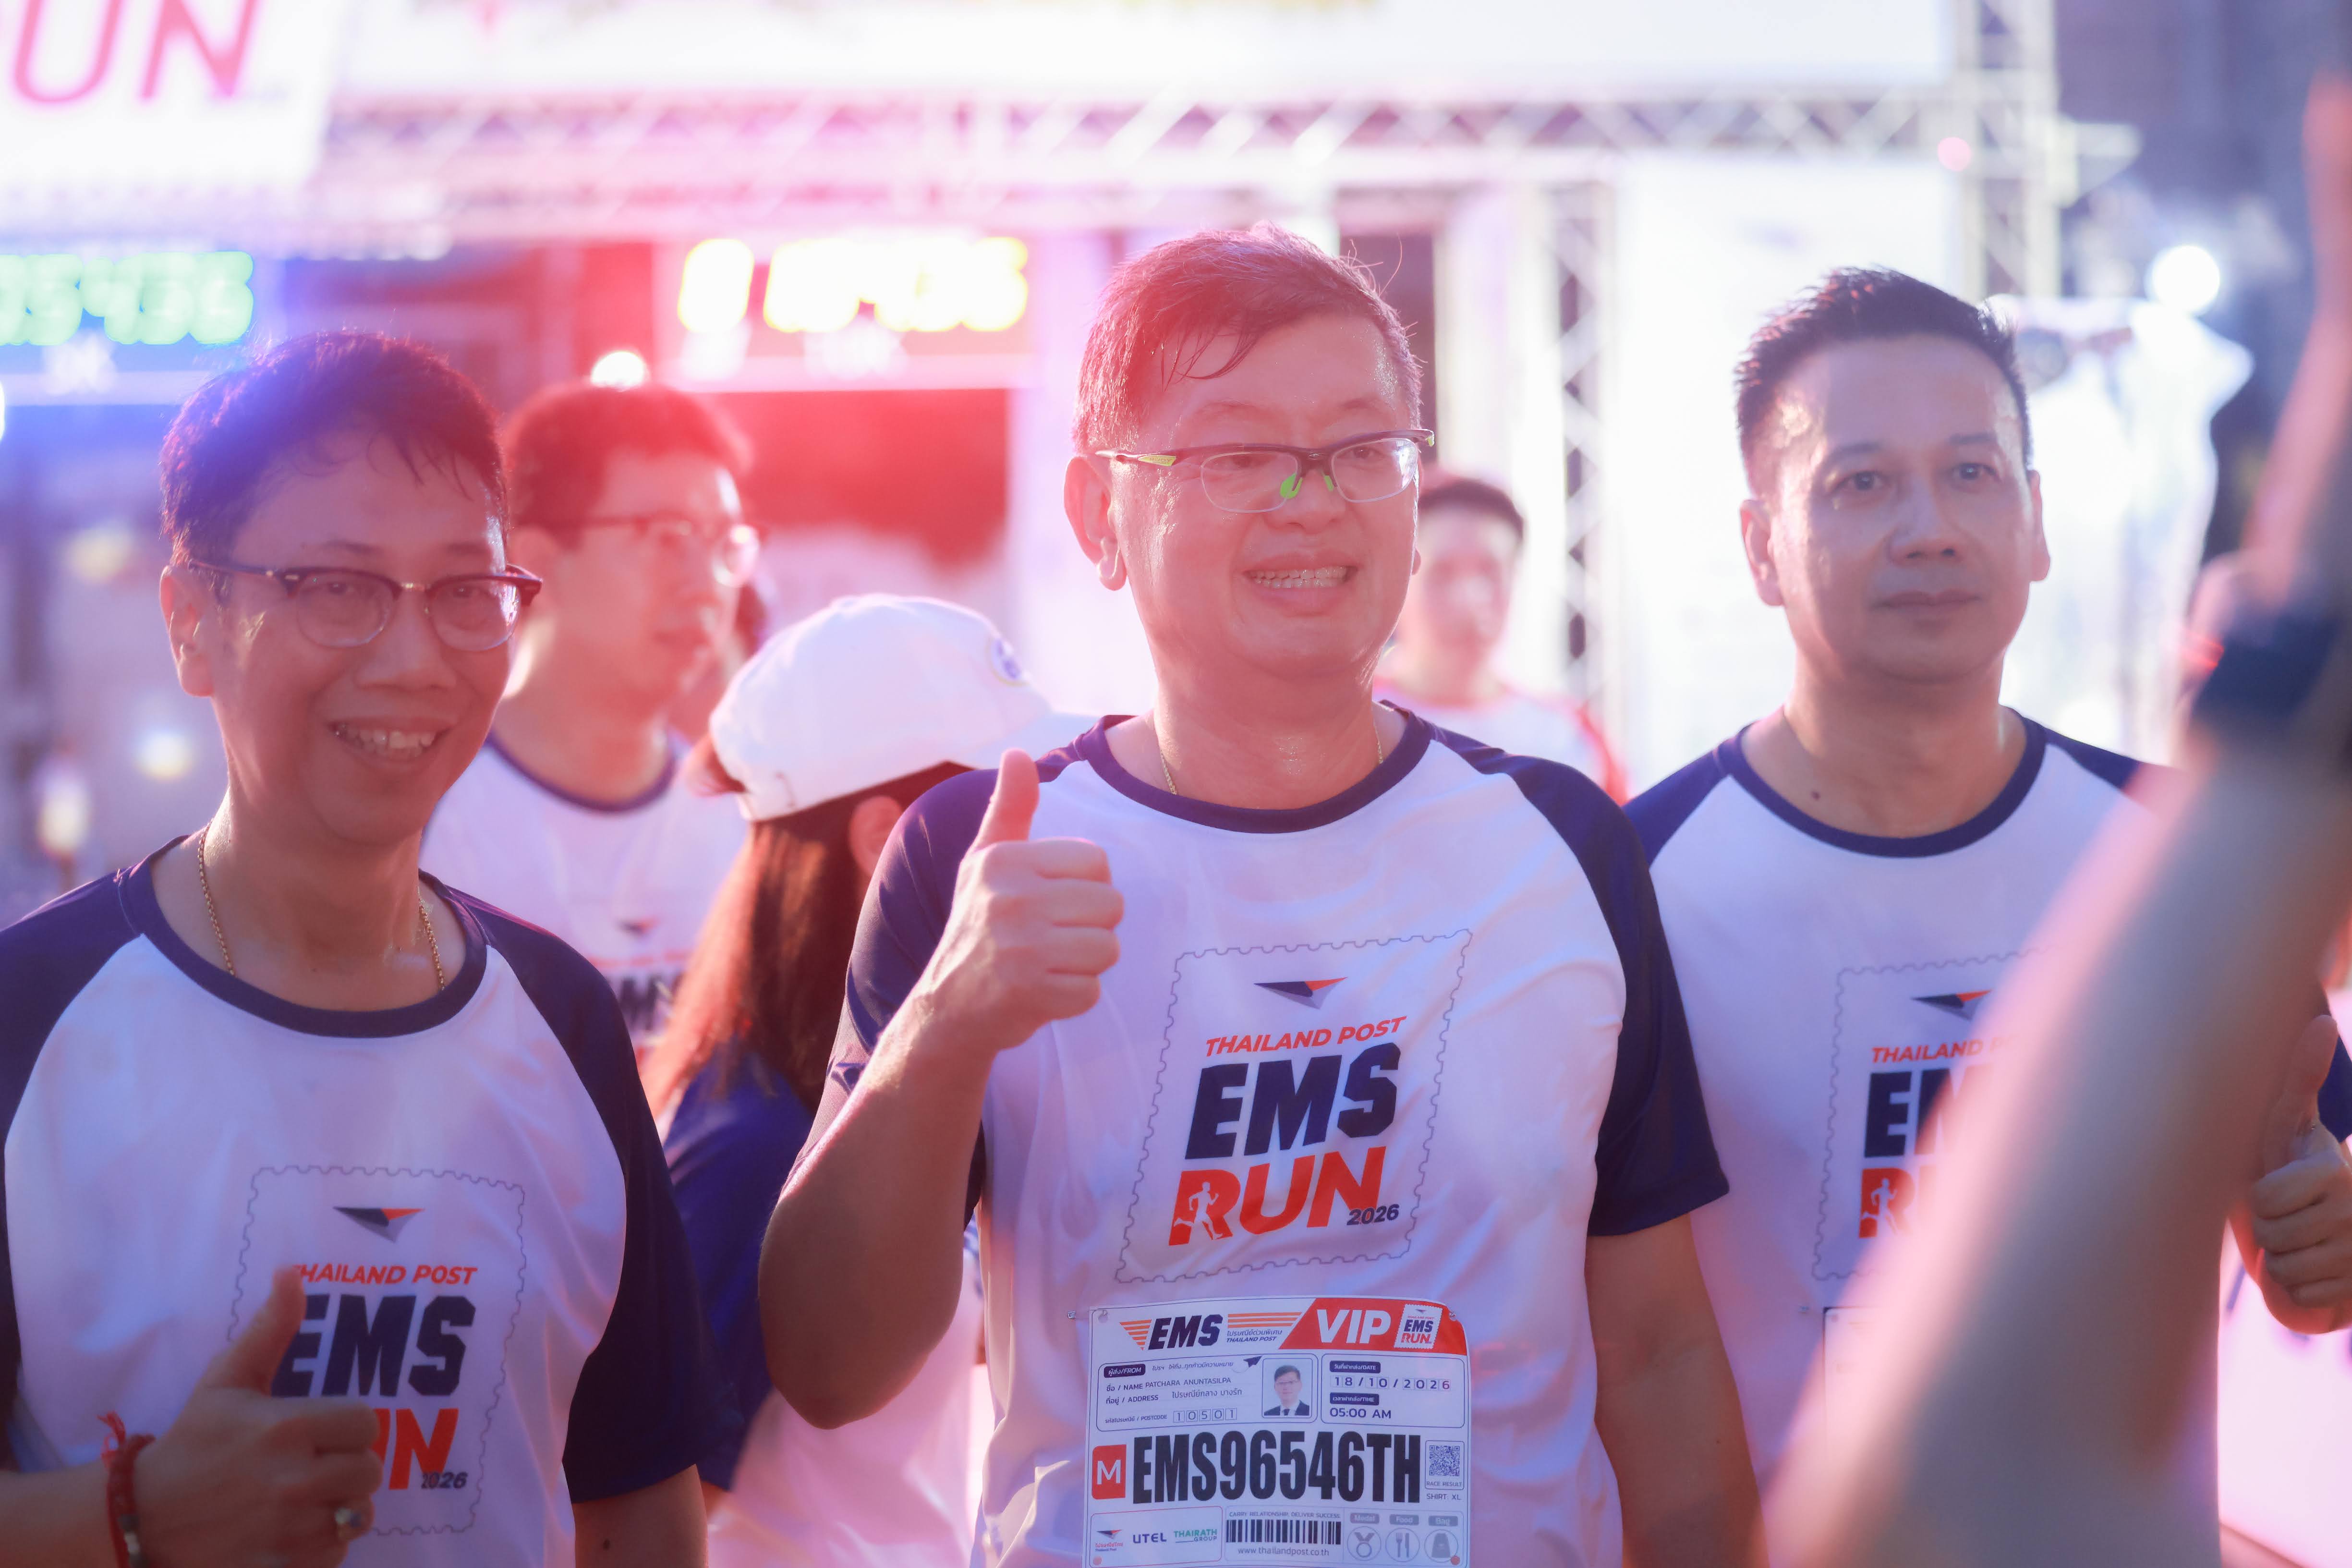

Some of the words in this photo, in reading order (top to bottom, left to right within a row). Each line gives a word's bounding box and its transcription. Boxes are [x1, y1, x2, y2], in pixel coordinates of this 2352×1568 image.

[1205, 1027, 1331, 1057] THAILAND
[1337, 1016, 1407, 1044] POST
[1872, 1039, 1983, 1063] THAILAND
[1185, 1042, 1401, 1160] EMS
[1864, 1063, 1995, 1158] EM
[1168, 1145, 1386, 1246] RUN
[1346, 1203, 1400, 1226] 2026
[412, 1264, 478, 1285] POST
[1148, 1314, 1224, 1350] EMS
[1317, 1309, 1392, 1344] VIP
[1404, 1319, 1434, 1333] EMS
[271, 1294, 476, 1398] EMS
[1401, 1333, 1431, 1344] RUN
[1106, 1383, 1115, 1391] ชื่อ
[1106, 1396, 1119, 1405] ที่อยู่
[1172, 1389, 1218, 1398] ไปรษณีย์กลาง
[1330, 1408, 1367, 1418] 05:00
[1372, 1410, 1392, 1419] AM
[1097, 1459, 1122, 1485] M
[1133, 1430, 1421, 1504] EMS96546TH
[421, 1471, 469, 1490] 2026
[1133, 1532, 1167, 1544] UTEL
[1174, 1529, 1217, 1537] THAIRATH
